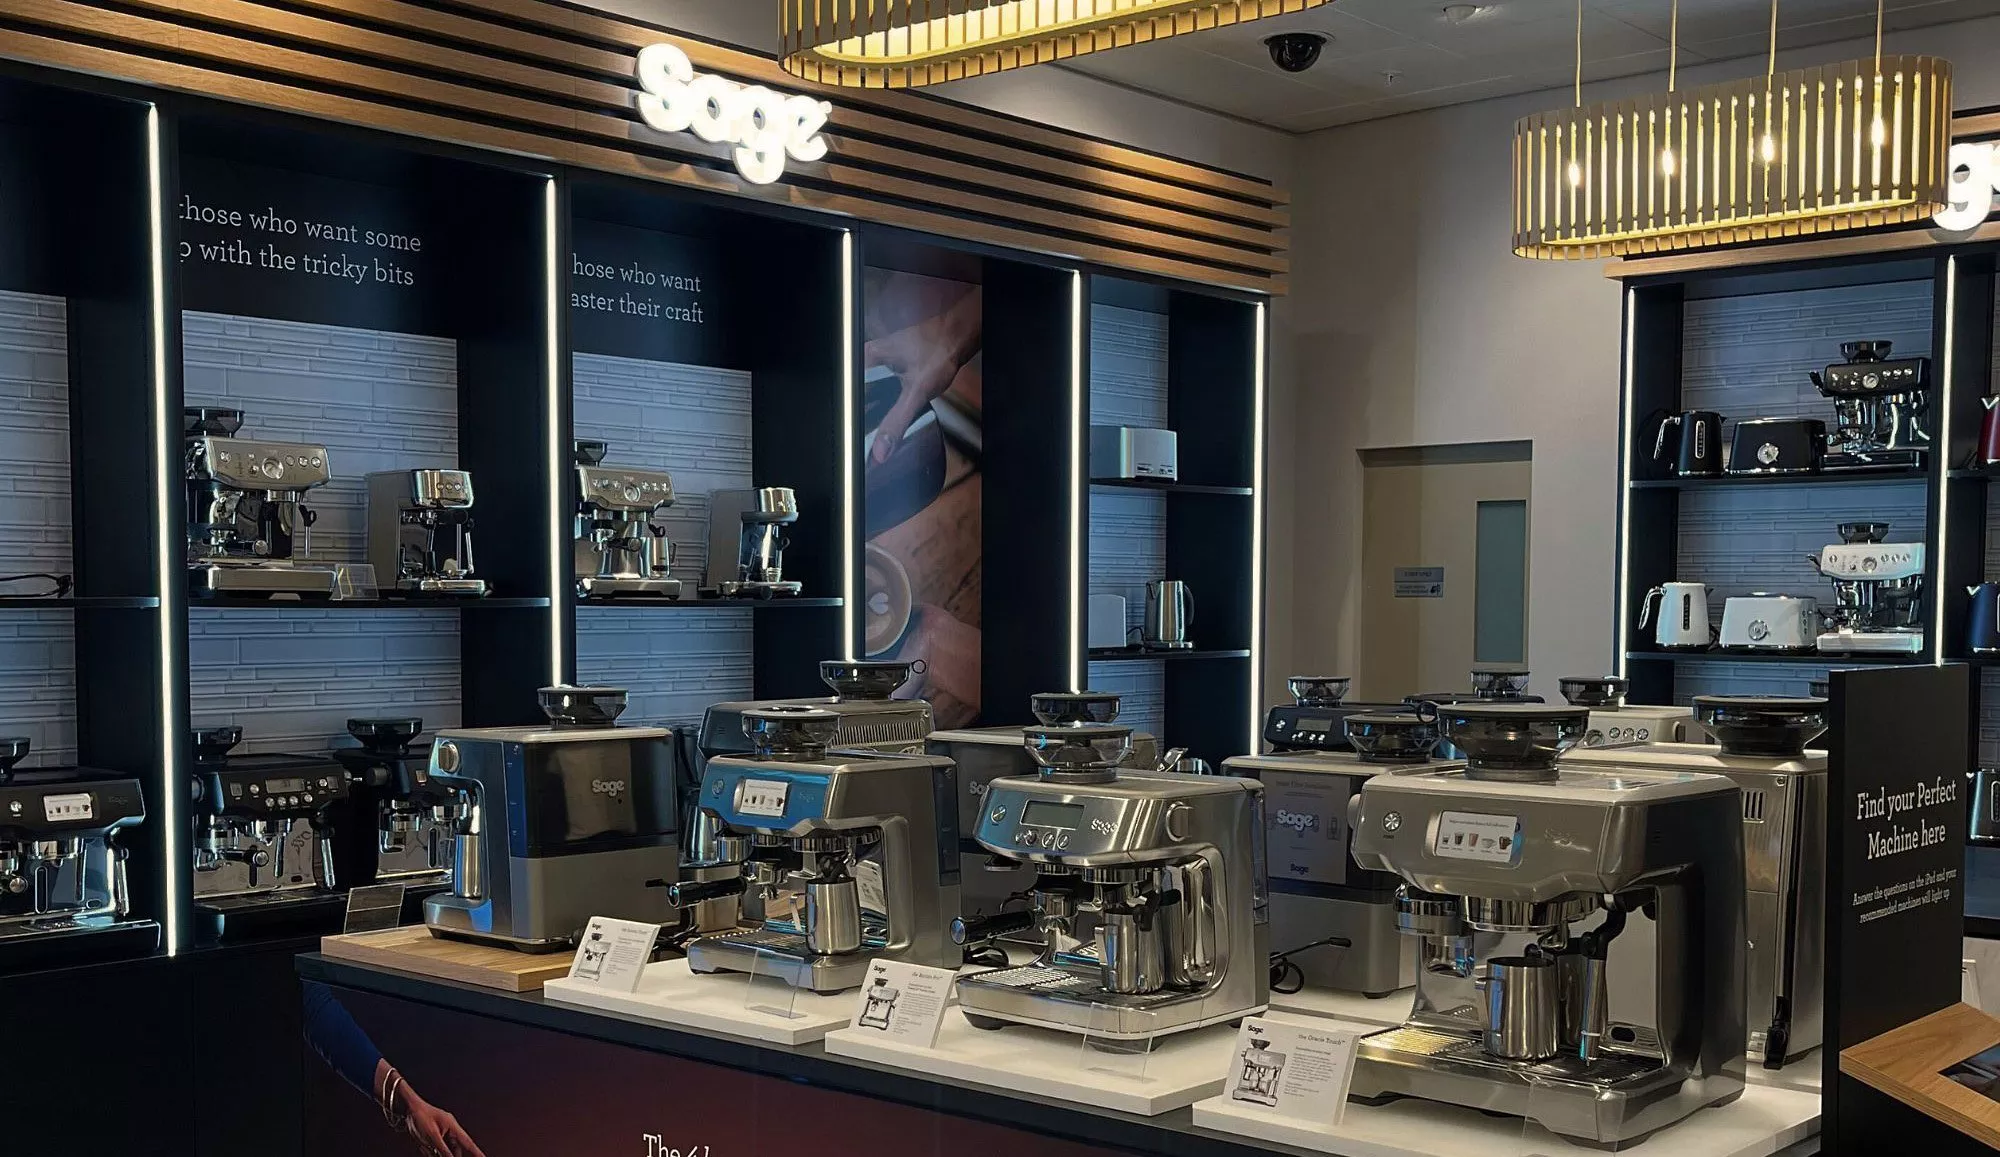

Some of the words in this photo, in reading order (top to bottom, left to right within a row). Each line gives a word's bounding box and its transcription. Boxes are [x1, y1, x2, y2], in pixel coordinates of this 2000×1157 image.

[635, 43, 833, 184] Sage
[249, 207, 297, 235] who
[304, 221, 358, 243] want
[365, 230, 421, 252] some
[199, 239, 252, 266] with
[259, 244, 296, 270] the
[303, 254, 368, 284] tricky
[374, 257, 414, 285] bits
[572, 253, 615, 279] hose
[620, 262, 656, 285] who
[660, 274, 702, 292] want
[571, 293, 614, 312] aster
[620, 292, 660, 318] their
[665, 302, 704, 323] craft
[592, 779, 624, 797] Sage
[1857, 786, 1885, 820] Find
[1887, 791, 1915, 821] your
[1917, 776, 1956, 808] Perfect
[1277, 809, 1313, 831] Sage
[1867, 824, 1918, 860] Machine
[1920, 818, 1946, 847] here
[1884, 883, 1908, 900] questions
[1916, 874, 1924, 888] the
[1247, 1025, 1264, 1035] Sage
